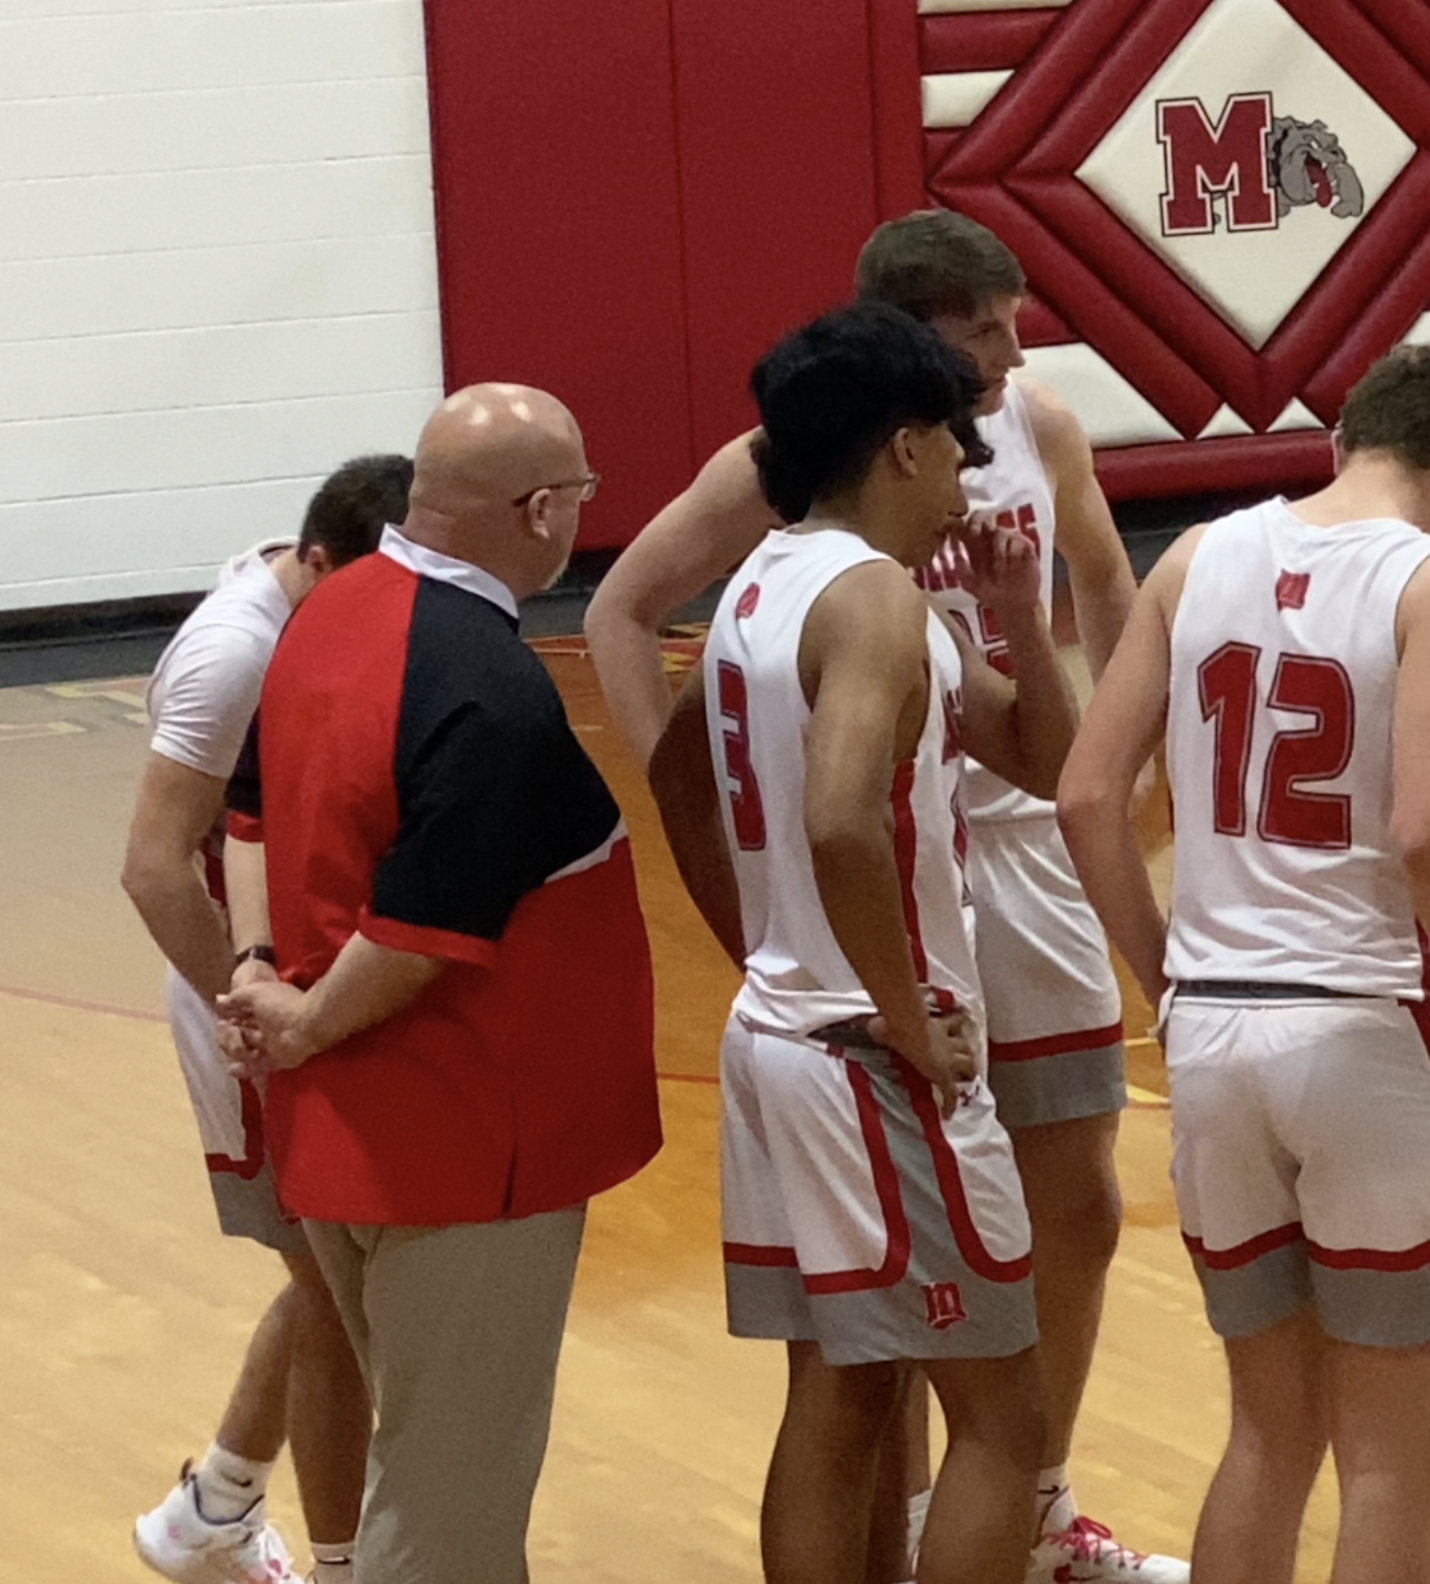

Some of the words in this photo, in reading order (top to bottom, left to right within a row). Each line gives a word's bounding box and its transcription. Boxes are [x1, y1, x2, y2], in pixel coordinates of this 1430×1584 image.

[1155, 91, 1279, 237] M
[717, 658, 767, 851] 3
[1197, 640, 1355, 849] 12
